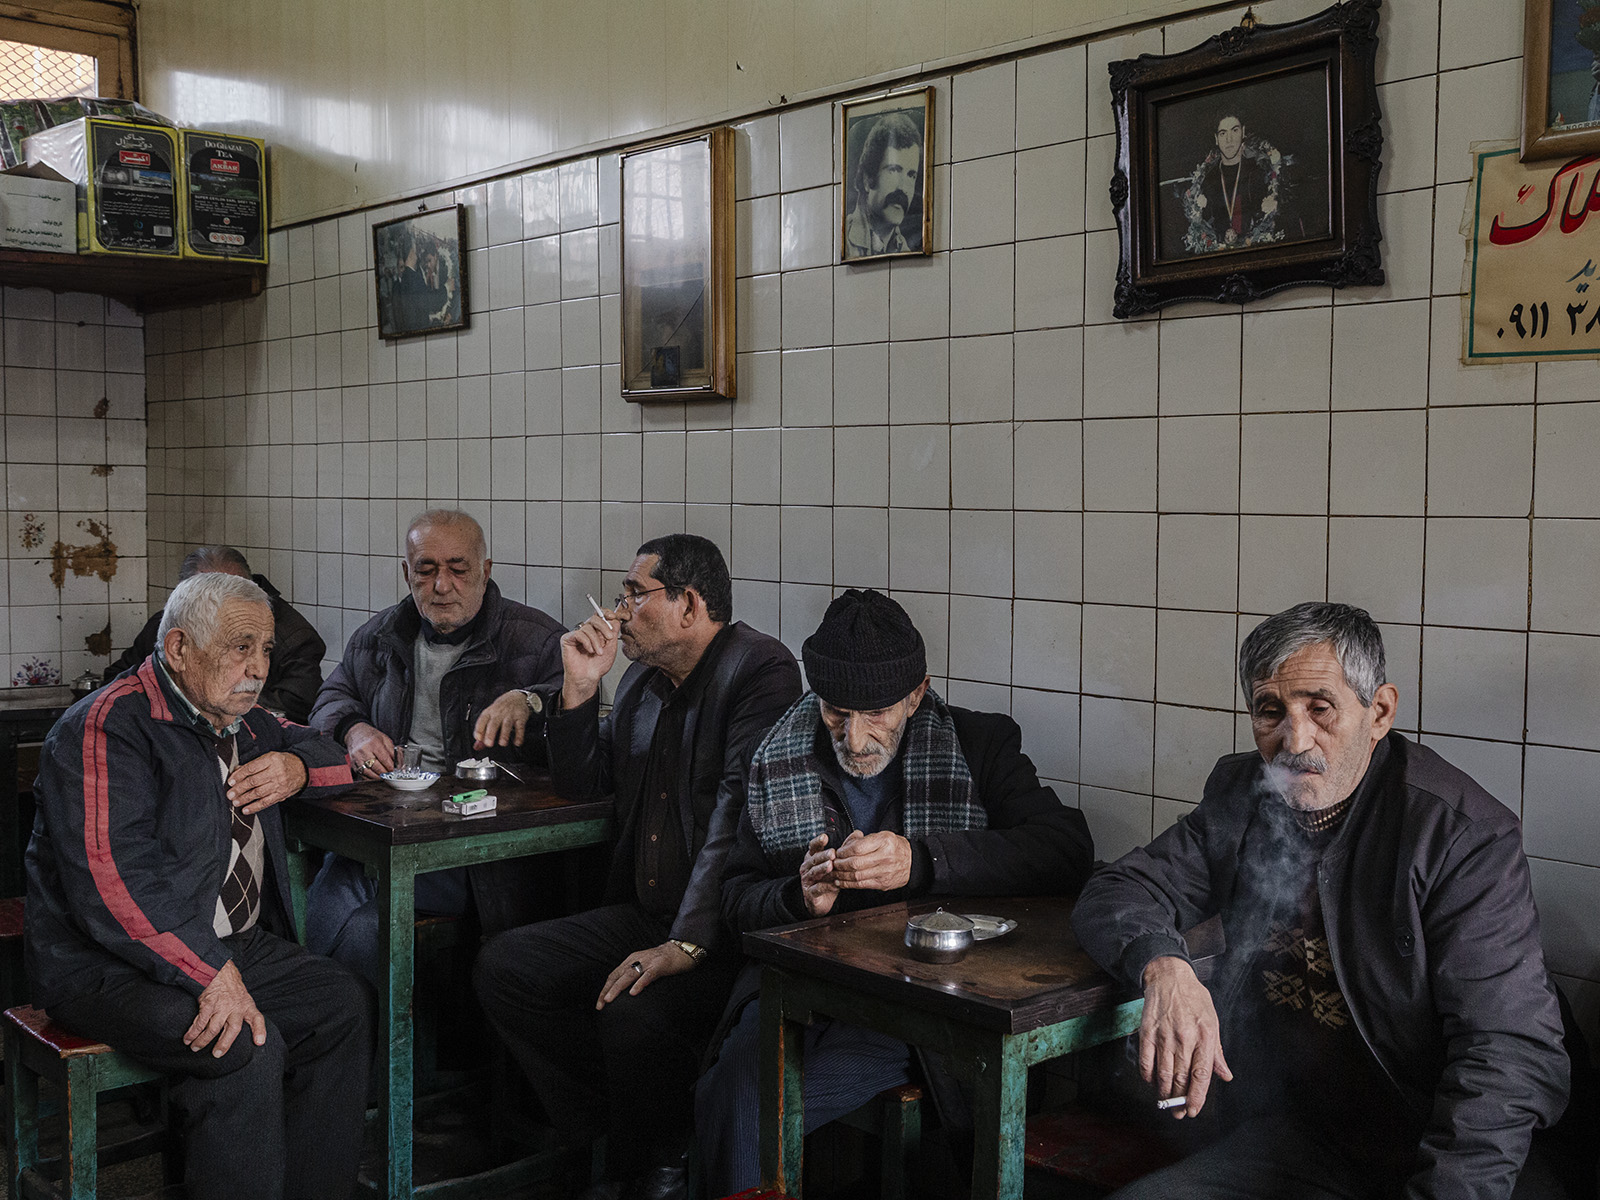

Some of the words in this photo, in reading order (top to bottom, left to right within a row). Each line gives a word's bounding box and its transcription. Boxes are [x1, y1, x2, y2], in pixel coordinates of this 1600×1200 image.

[204, 140, 216, 149] DO
[216, 141, 244, 152] GHAZAL
[216, 150, 233, 158] TEA
[212, 163, 238, 171] AKBAR
